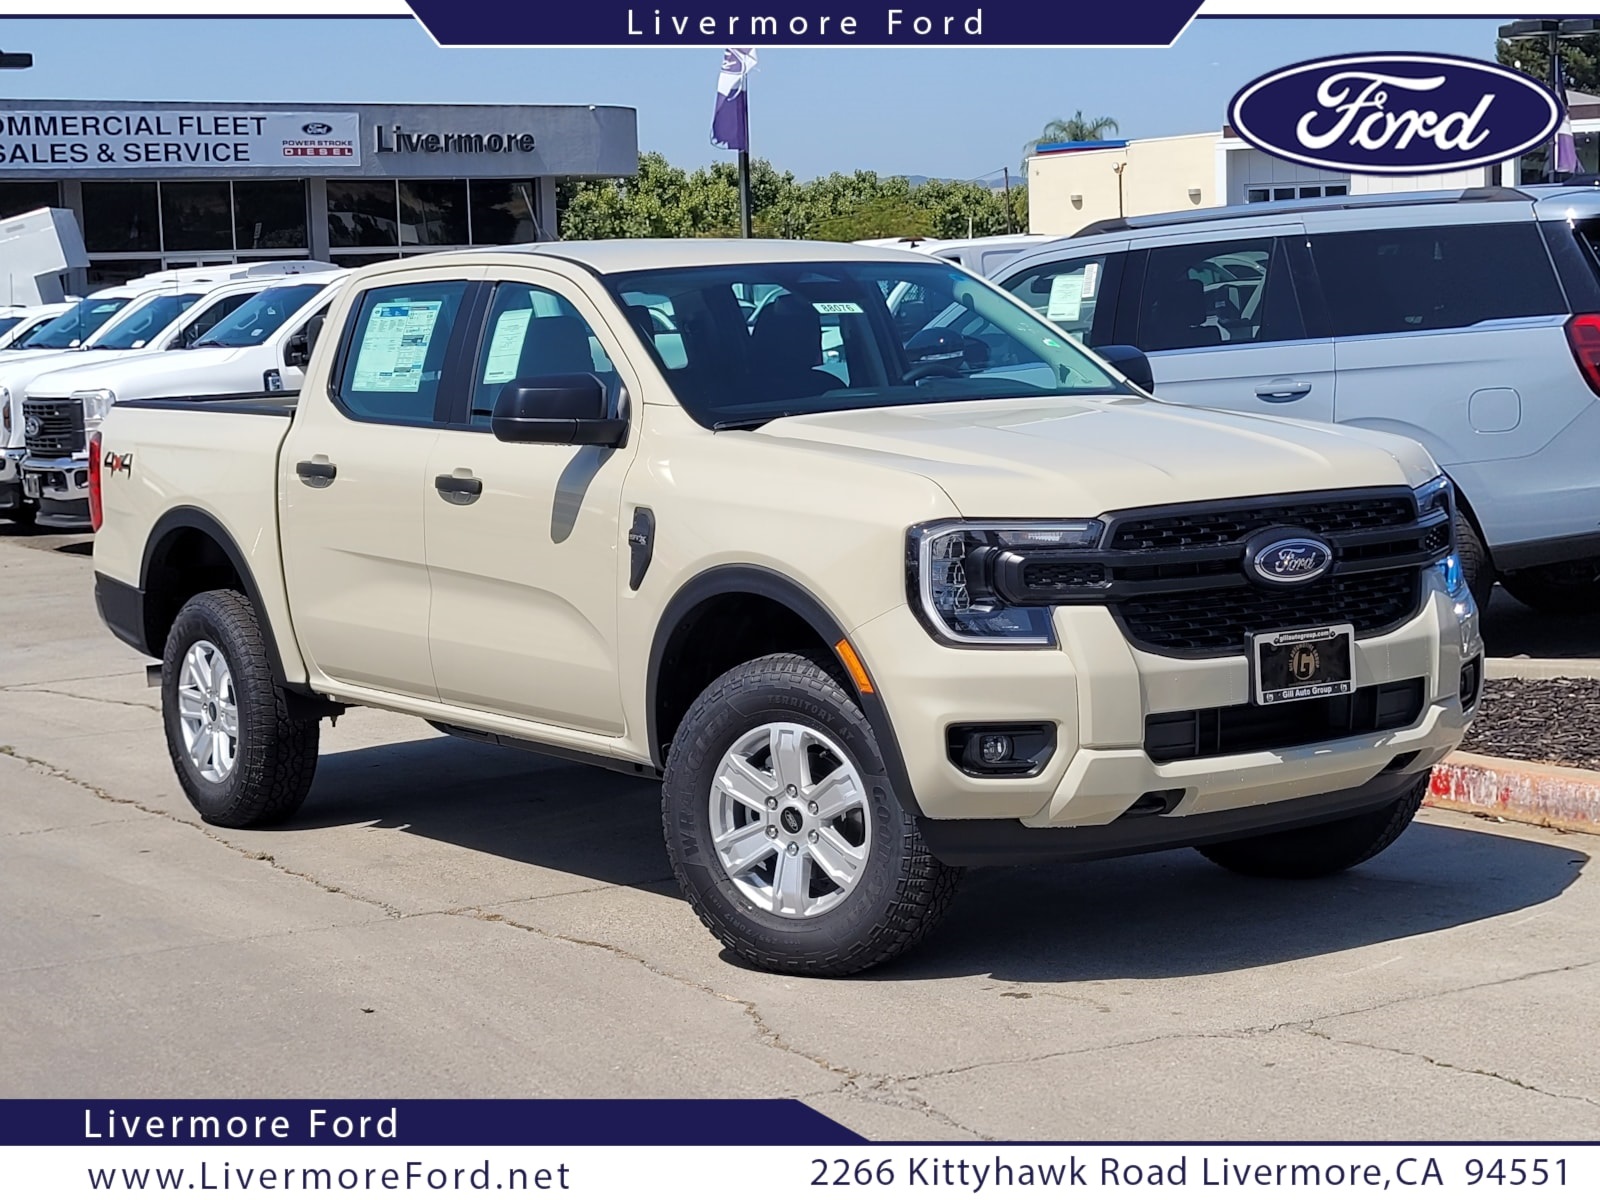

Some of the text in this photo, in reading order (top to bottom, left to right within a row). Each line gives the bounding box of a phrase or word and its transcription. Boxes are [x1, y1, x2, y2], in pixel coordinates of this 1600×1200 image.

[0, 115, 267, 136] MMERCIAL FLEET
[374, 125, 536, 153] Livermore
[97, 143, 117, 163] &
[123, 142, 250, 162] SERVICE
[284, 148, 352, 156] DIESEL
[821, 304, 855, 312] 88076
[1275, 548, 1317, 573] Ford
[1279, 630, 1330, 643] gillautogroup.com
[1282, 690, 1294, 699] Gill
[1295, 688, 1311, 697] Auto
[1311, 686, 1332, 696] Group
[767, 694, 836, 723] TERRITORY
